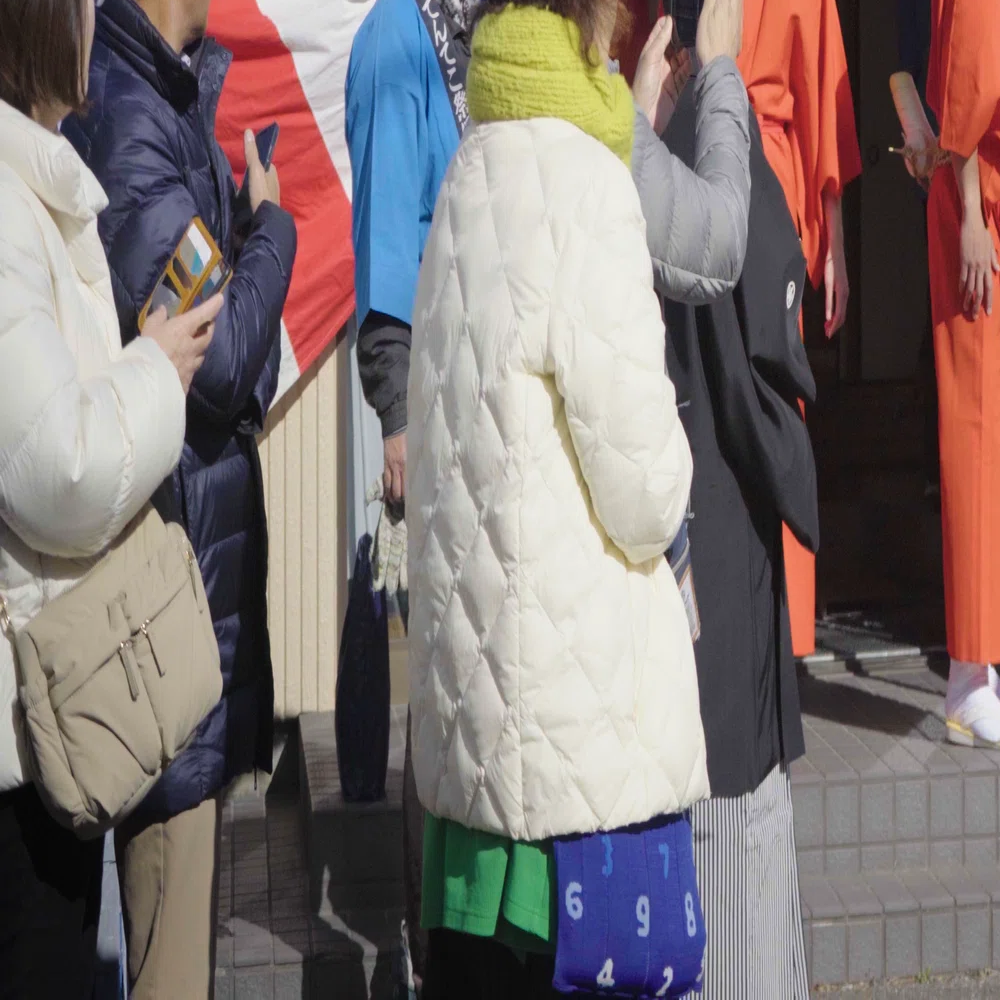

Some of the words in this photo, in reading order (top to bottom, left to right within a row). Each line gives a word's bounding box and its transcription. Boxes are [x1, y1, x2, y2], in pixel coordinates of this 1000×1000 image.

[565, 881, 584, 921] 6
[635, 895, 650, 937] 9
[684, 891, 697, 937] 8
[596, 957, 615, 988] 4
[655, 965, 674, 997] 2
